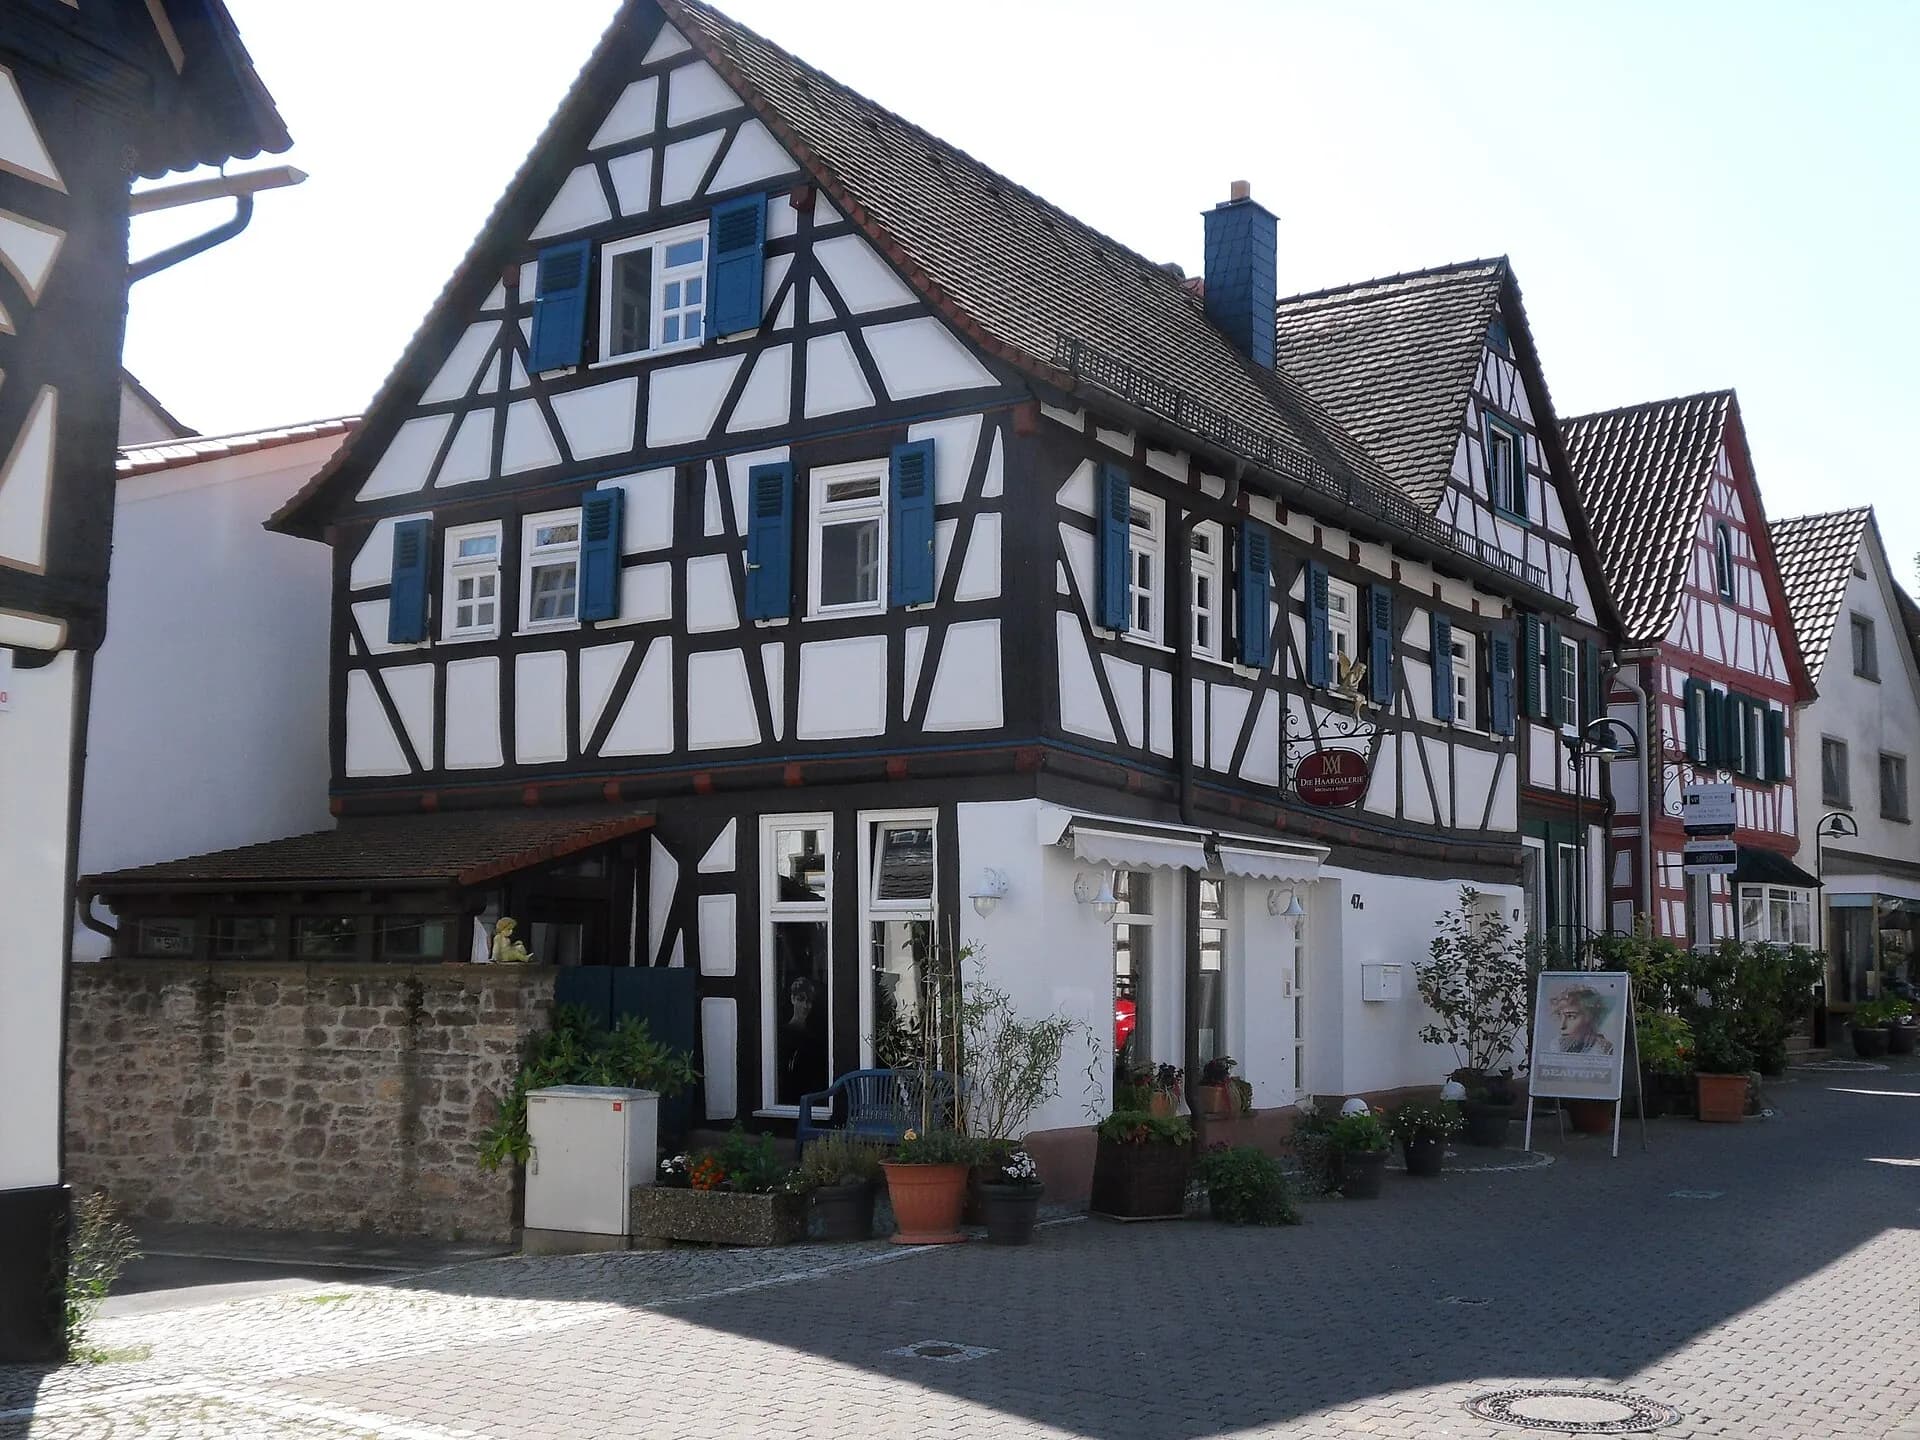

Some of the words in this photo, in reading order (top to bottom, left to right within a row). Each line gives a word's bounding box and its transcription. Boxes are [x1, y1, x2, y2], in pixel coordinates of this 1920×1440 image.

[1300, 778, 1313, 787] DIE
[1314, 776, 1364, 786] HAARGALERIE
[1351, 894, 1363, 909] 47a
